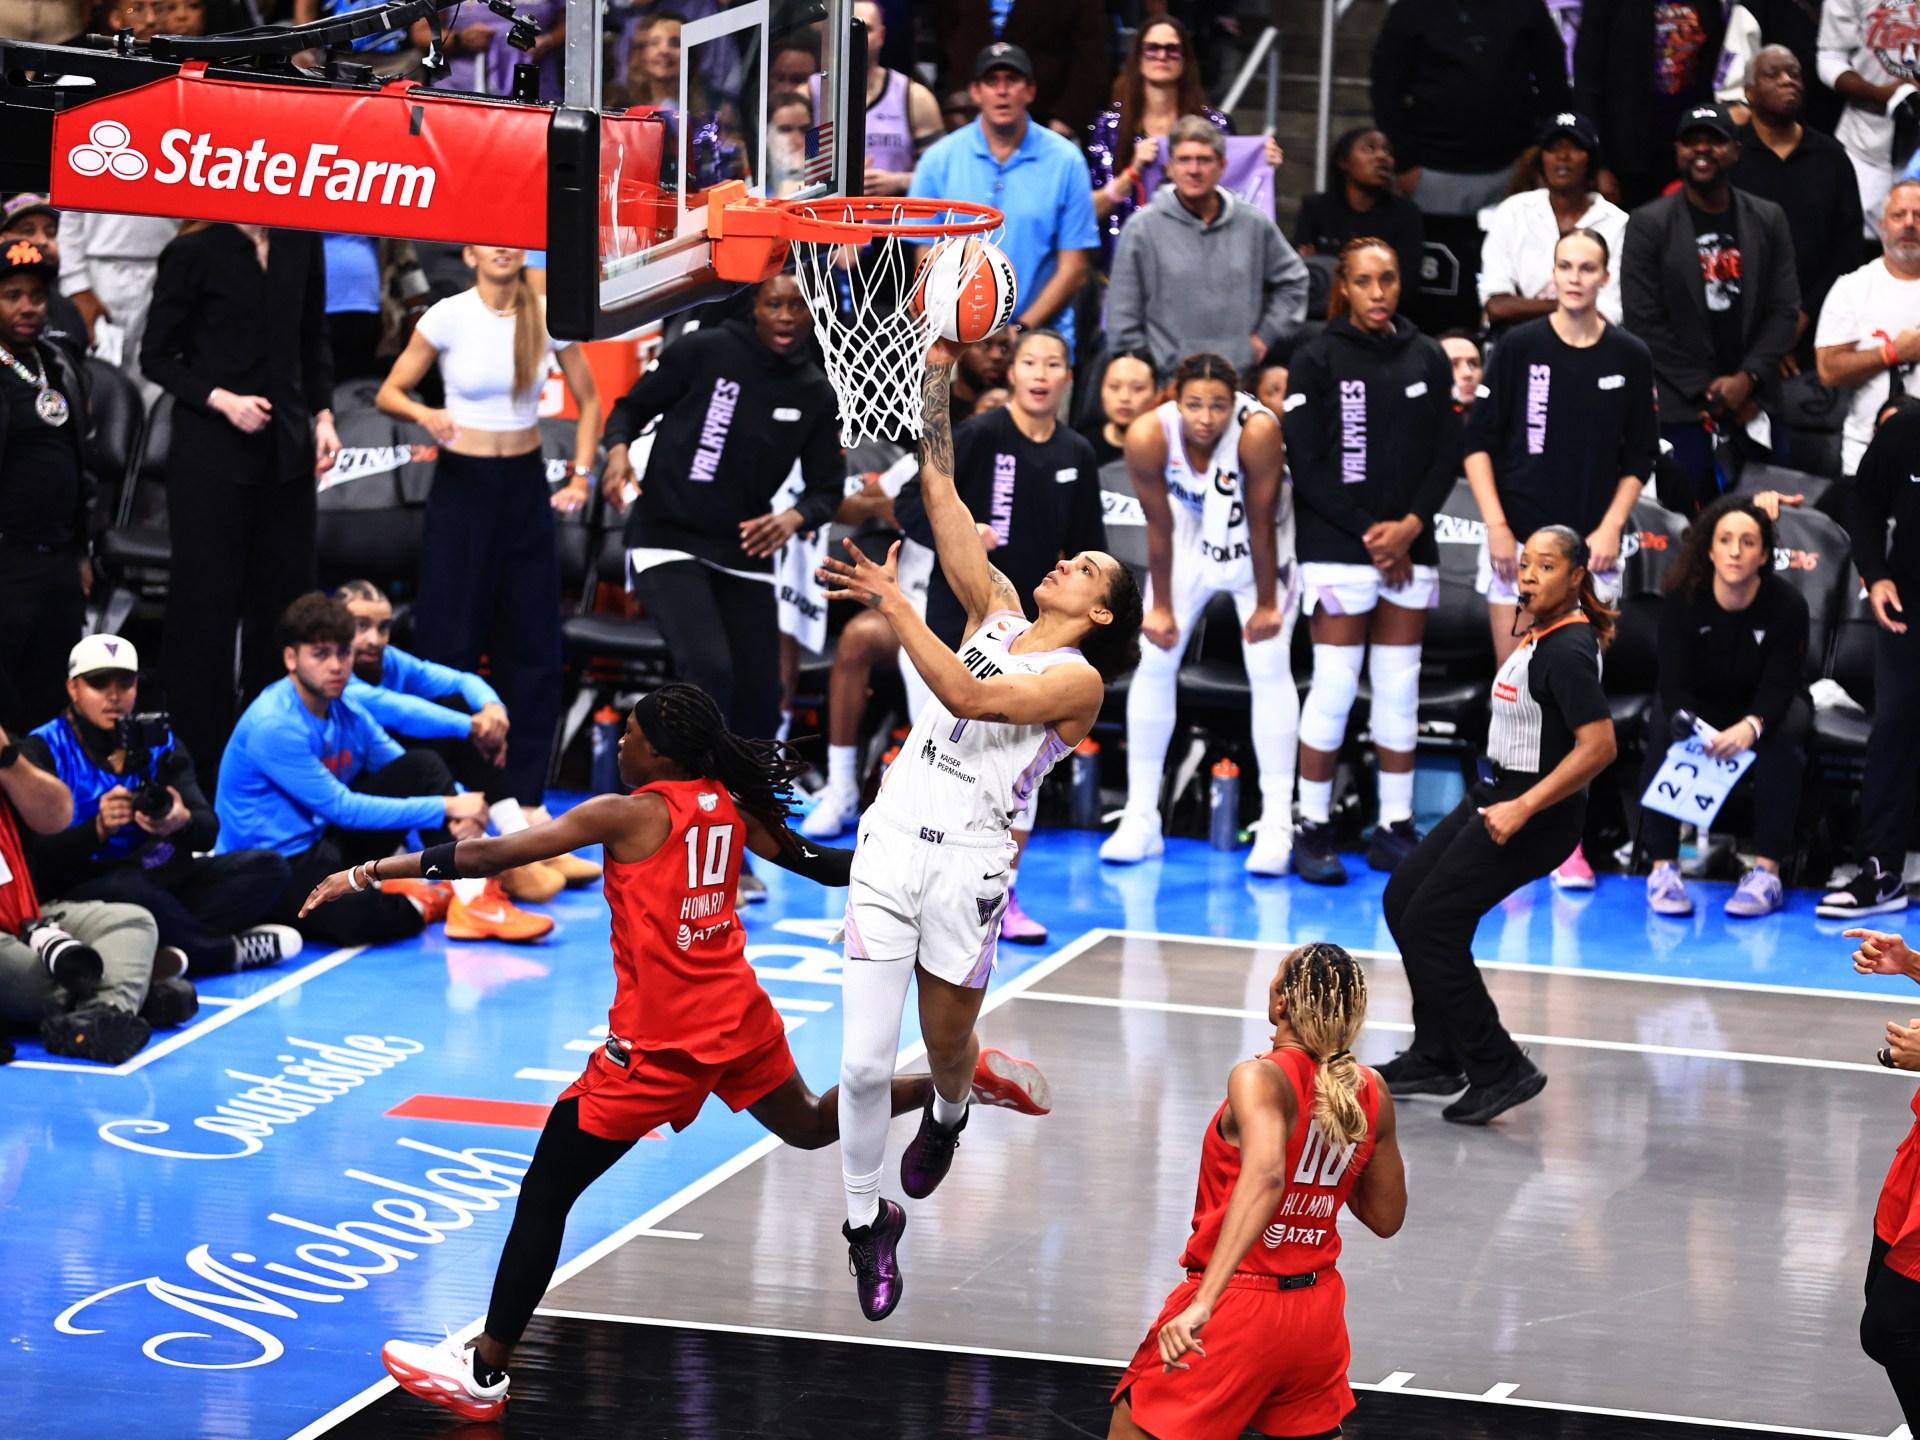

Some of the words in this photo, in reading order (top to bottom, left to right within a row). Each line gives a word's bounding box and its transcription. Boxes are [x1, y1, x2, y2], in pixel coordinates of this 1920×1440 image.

[688, 376, 741, 482] VALKYRIES
[1340, 380, 1367, 484] VALKYRIES
[1526, 363, 1551, 454] VALKYRIES
[940, 752, 961, 769] KAISER
[1694, 793, 1716, 811] 4
[684, 824, 733, 889] 10
[919, 825, 945, 845] GSV
[680, 891, 725, 920] HOWARD
[98, 1033, 425, 1161] Courtside
[53, 1136, 536, 1370] Michelob
[1283, 1226, 1327, 1246] AT&T
